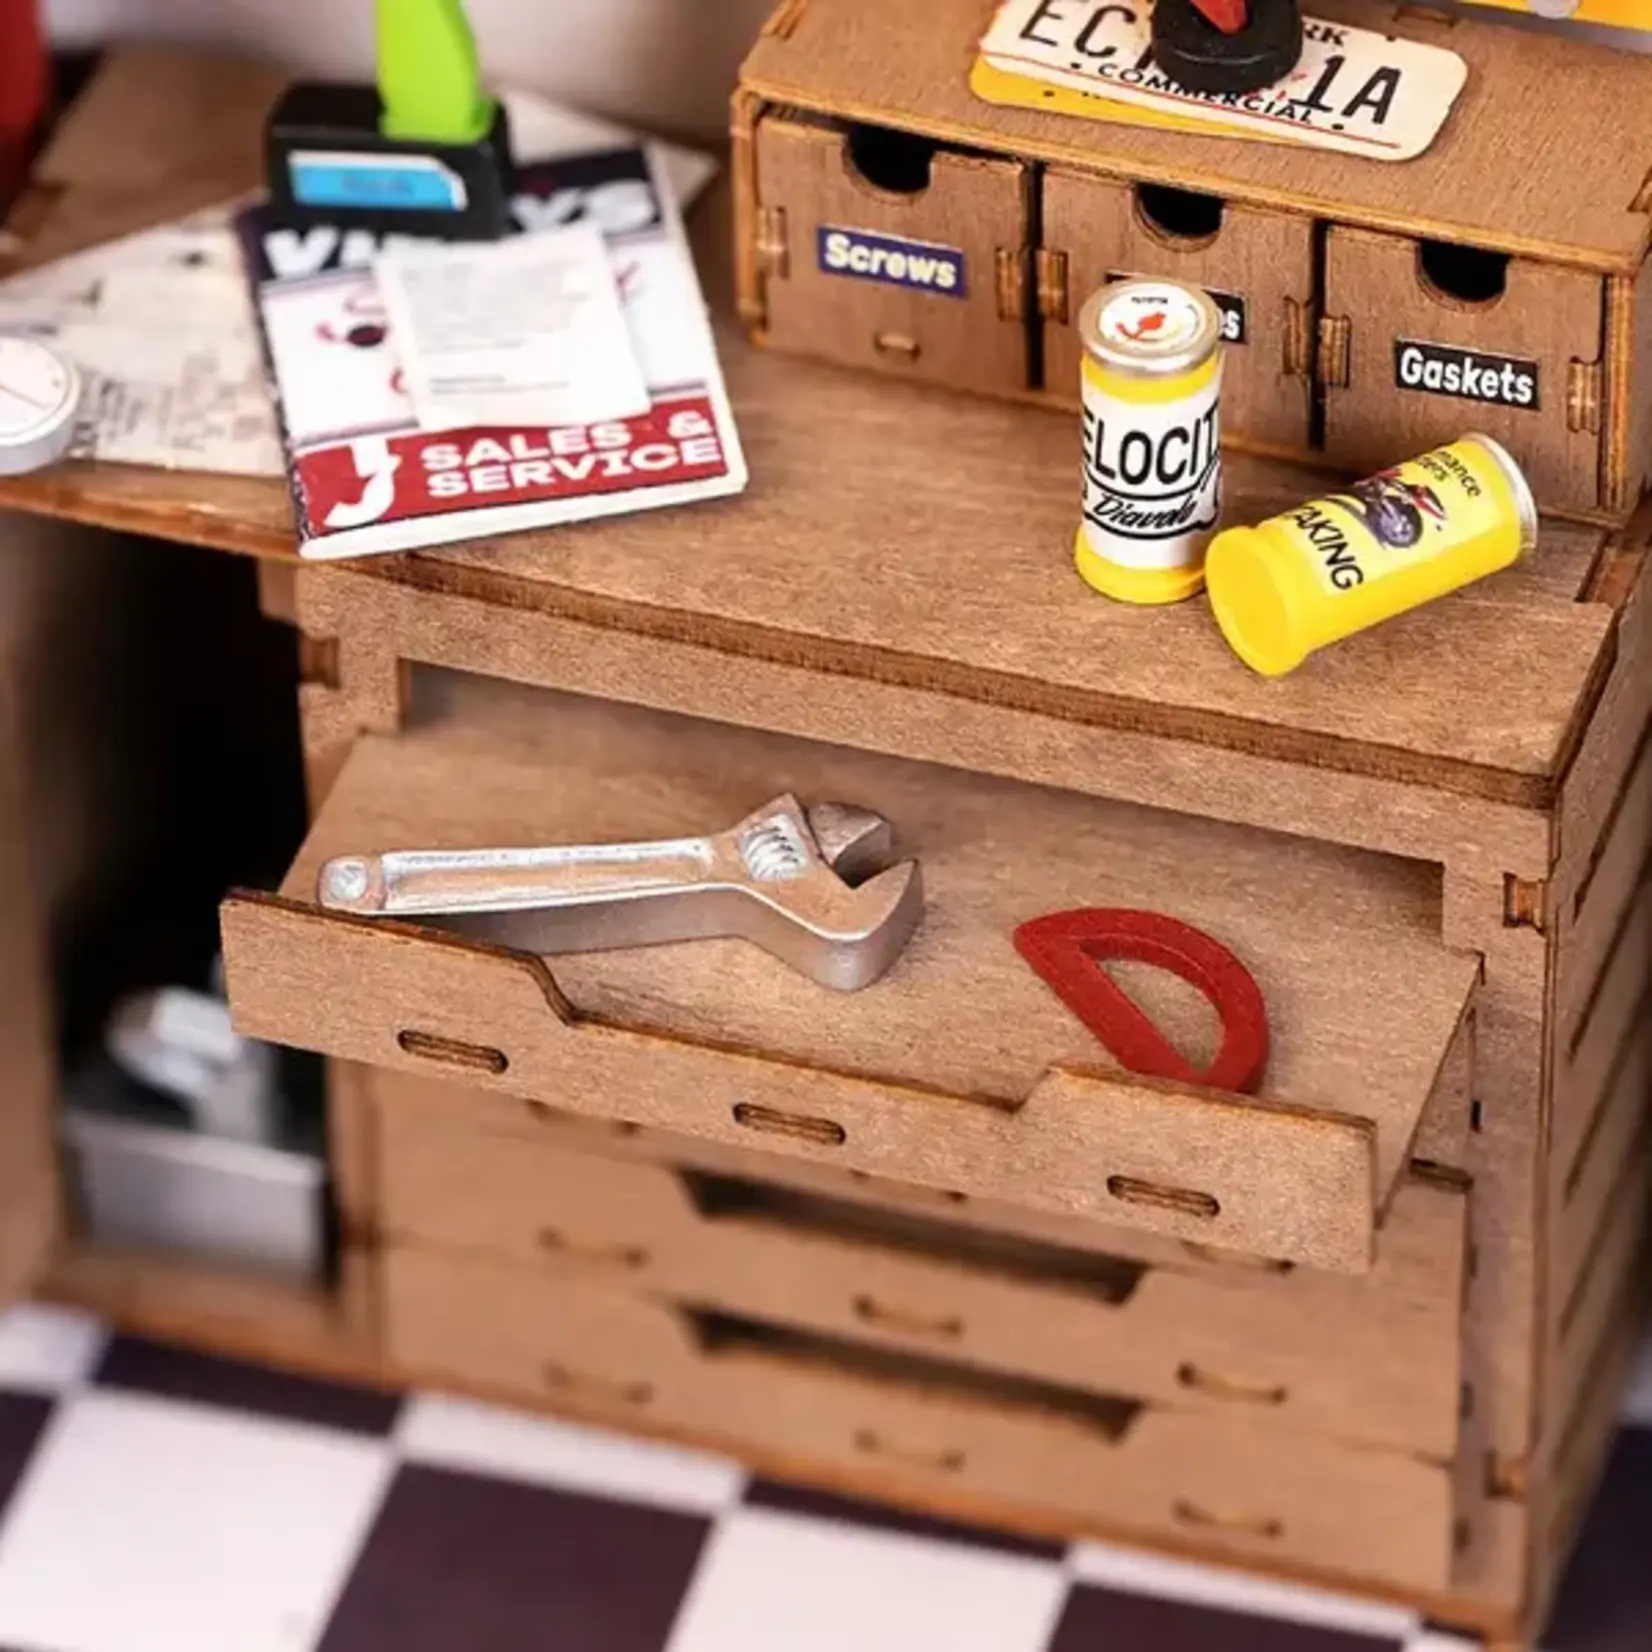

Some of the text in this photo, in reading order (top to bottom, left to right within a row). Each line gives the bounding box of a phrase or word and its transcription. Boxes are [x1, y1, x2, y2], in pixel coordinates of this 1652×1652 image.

[824, 233, 957, 289] Screws
[1400, 346, 1535, 404] Gaskets
[421, 410, 713, 472] SALES &
[427, 436, 722, 498] SERVICE
